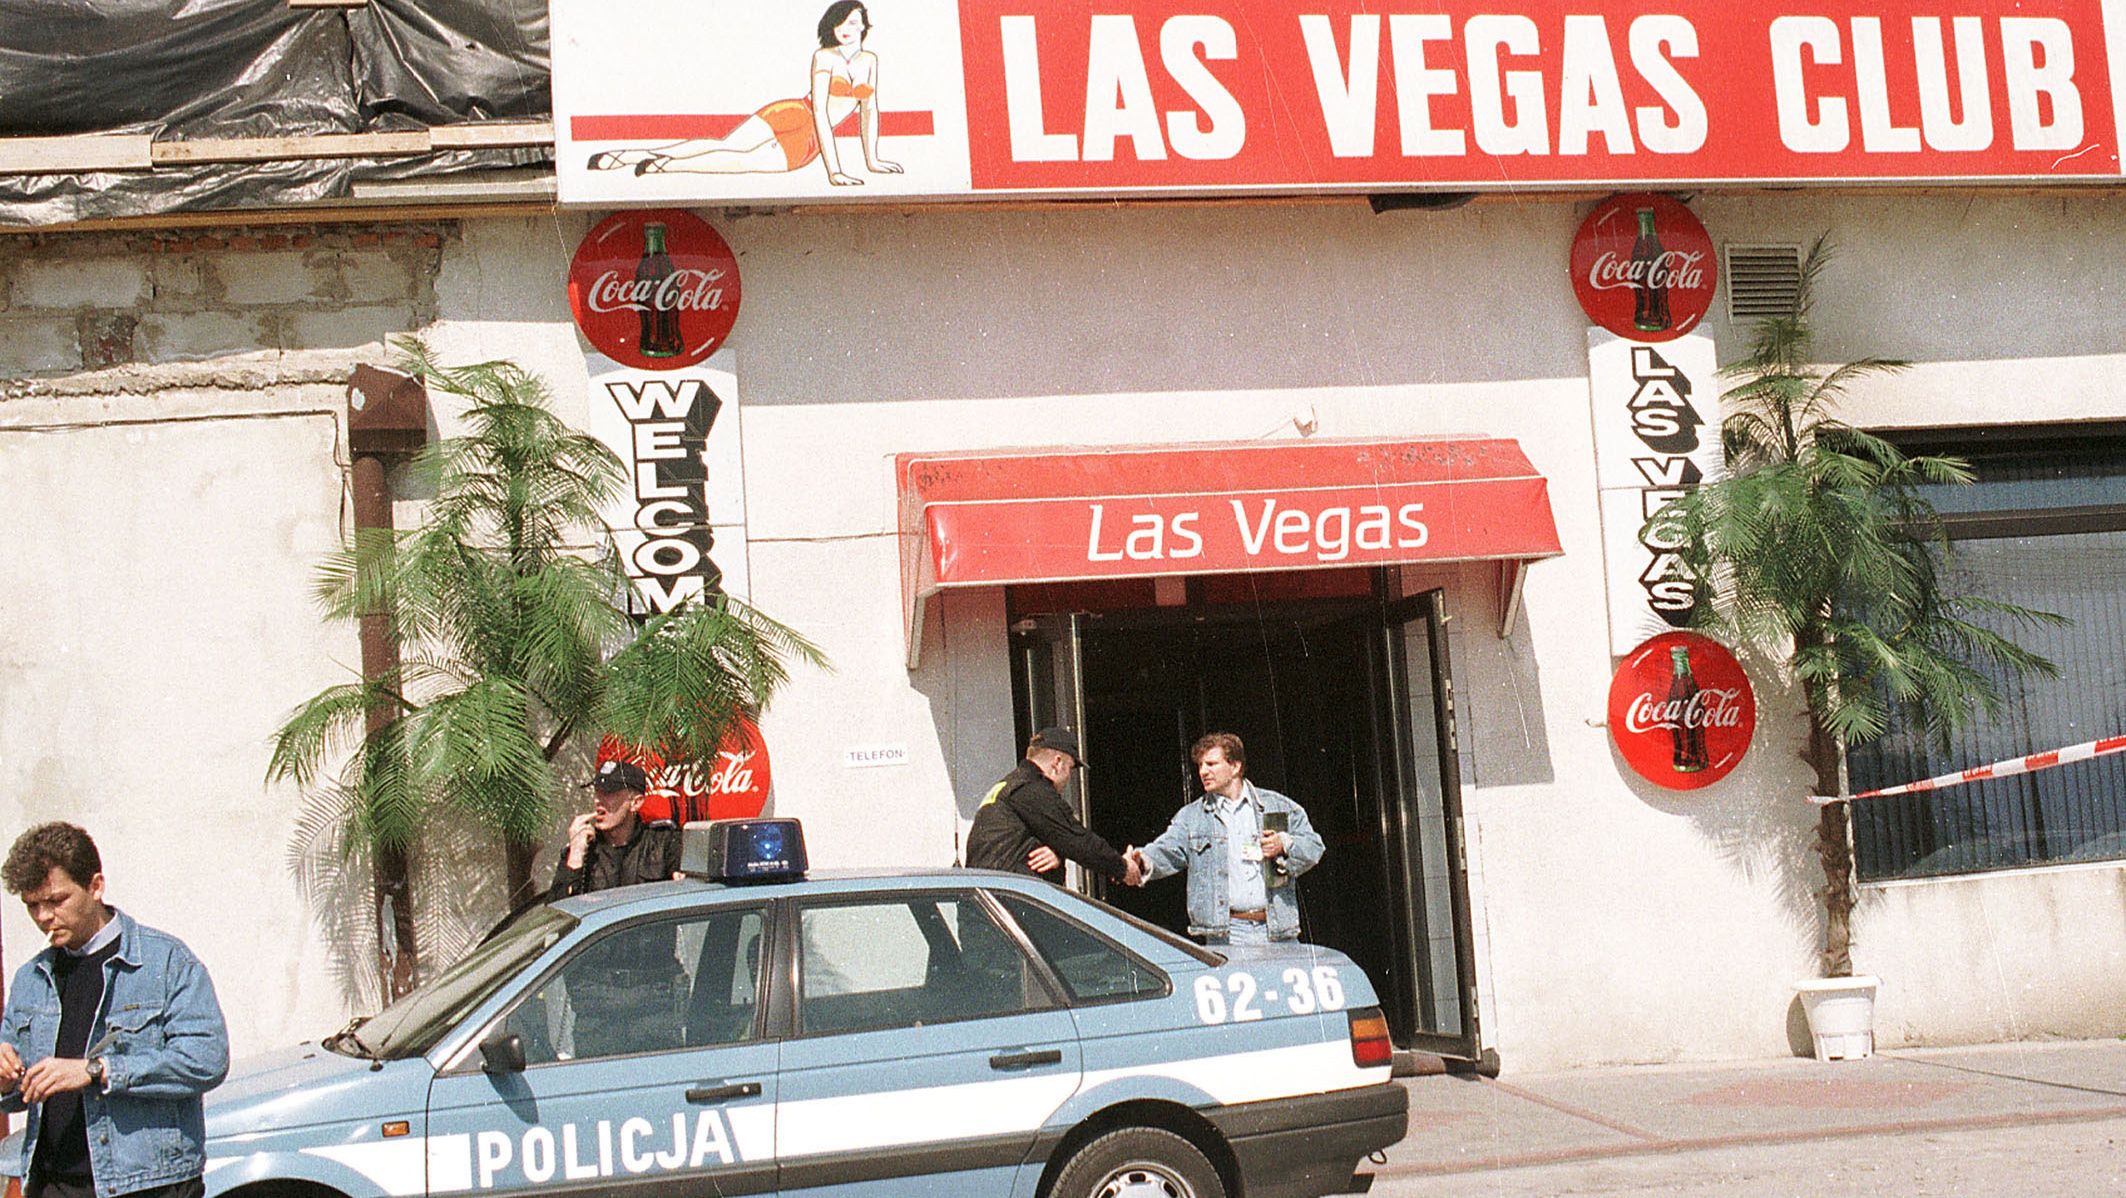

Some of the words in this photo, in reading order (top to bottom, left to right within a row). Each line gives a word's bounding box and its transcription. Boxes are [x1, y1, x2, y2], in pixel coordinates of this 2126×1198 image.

[1000, 14, 1246, 163] LAS
[1298, 13, 1708, 158] VEGAS
[1769, 15, 2085, 153] CLUB
[587, 268, 727, 313] Coca-Cola
[1588, 250, 1705, 290] Coca-Cola
[1627, 346, 1704, 454] LAS
[605, 379, 724, 617] WELCOM
[1087, 503, 1204, 562] Las
[1229, 498, 1431, 561] Vegas
[1625, 687, 1741, 733] Coca-Cola
[1193, 965, 1345, 1025] 62-36
[477, 1108, 736, 1189] POLICJA
